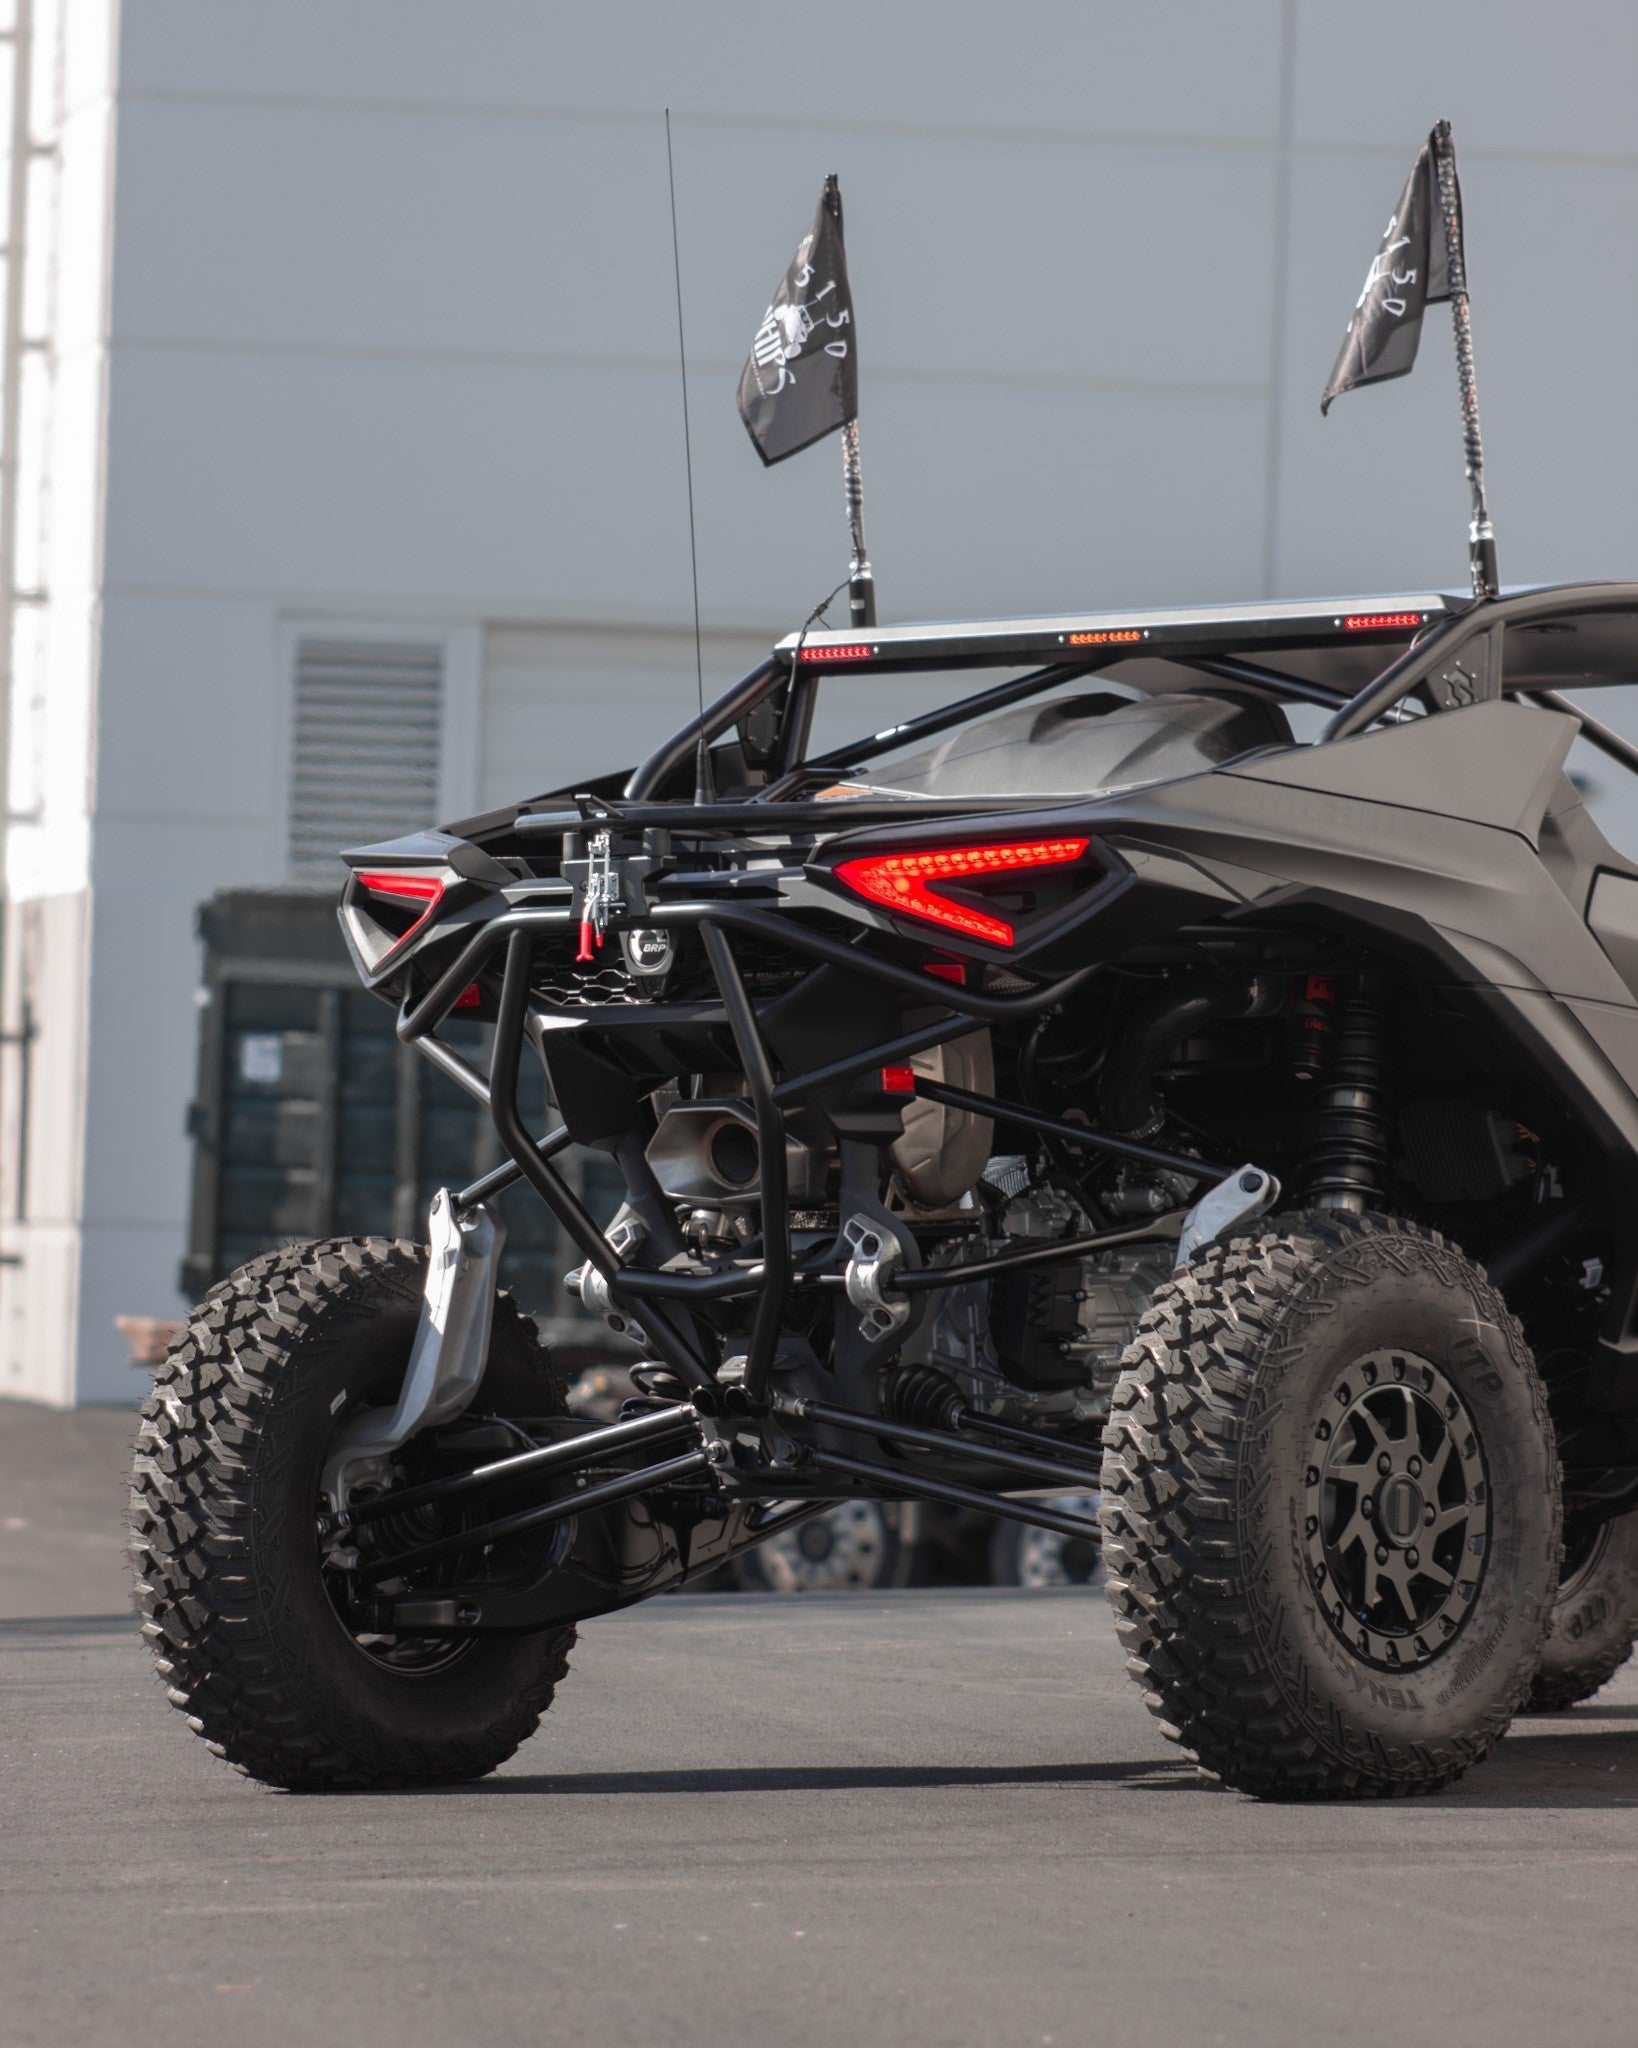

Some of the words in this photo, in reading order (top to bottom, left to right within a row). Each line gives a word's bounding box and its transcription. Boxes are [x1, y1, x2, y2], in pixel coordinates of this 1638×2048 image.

[795, 263, 850, 359] 5150
[643, 943, 667, 953] BRP
[1453, 1337, 1504, 1392] ITP
[1571, 1596, 1607, 1640] ITP
